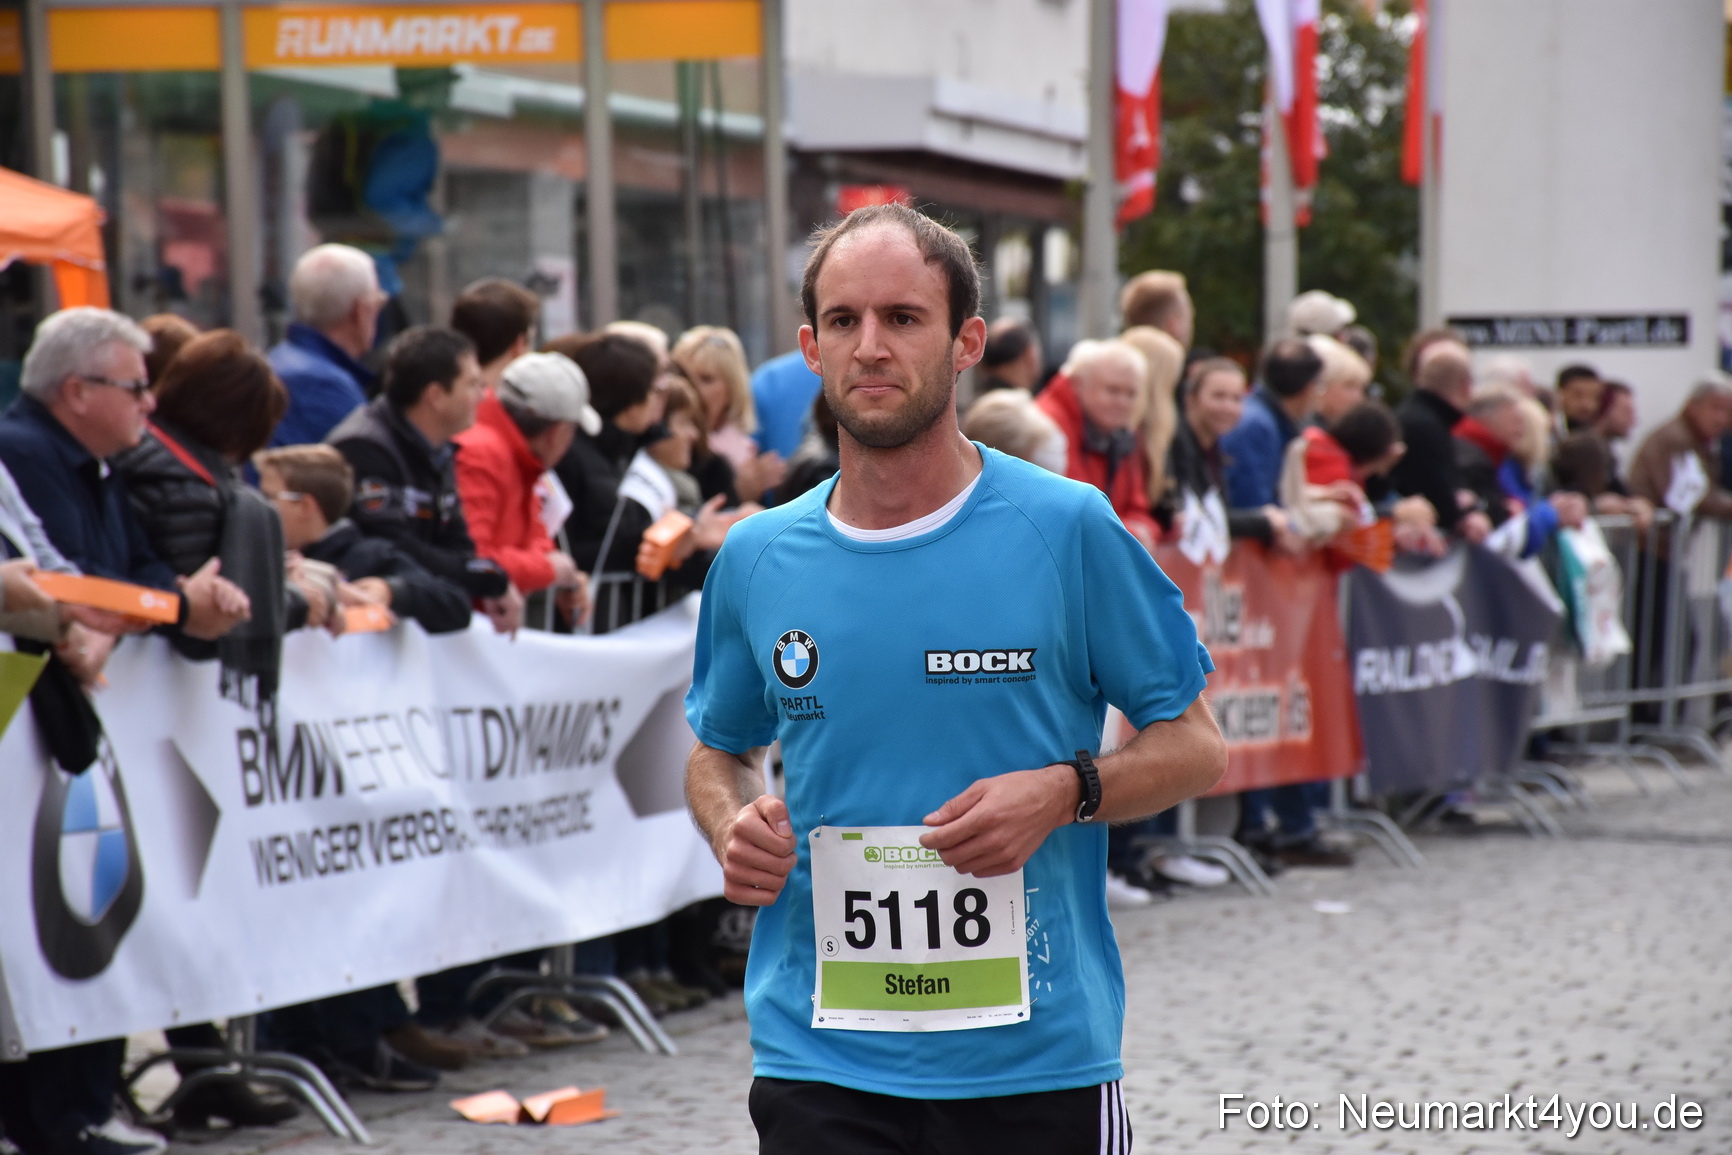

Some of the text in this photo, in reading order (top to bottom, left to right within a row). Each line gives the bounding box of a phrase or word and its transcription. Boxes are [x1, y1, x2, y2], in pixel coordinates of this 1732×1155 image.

[776, 630, 815, 652] BMW
[925, 648, 1038, 675] BOCK
[925, 673, 1037, 686] inspired by smart concepts
[780, 695, 823, 711] PARTL
[786, 710, 826, 722] Neumarkt
[883, 846, 942, 863] BOC
[844, 887, 991, 951] 5118
[826, 940, 834, 952] S
[885, 973, 951, 996] Stefan
